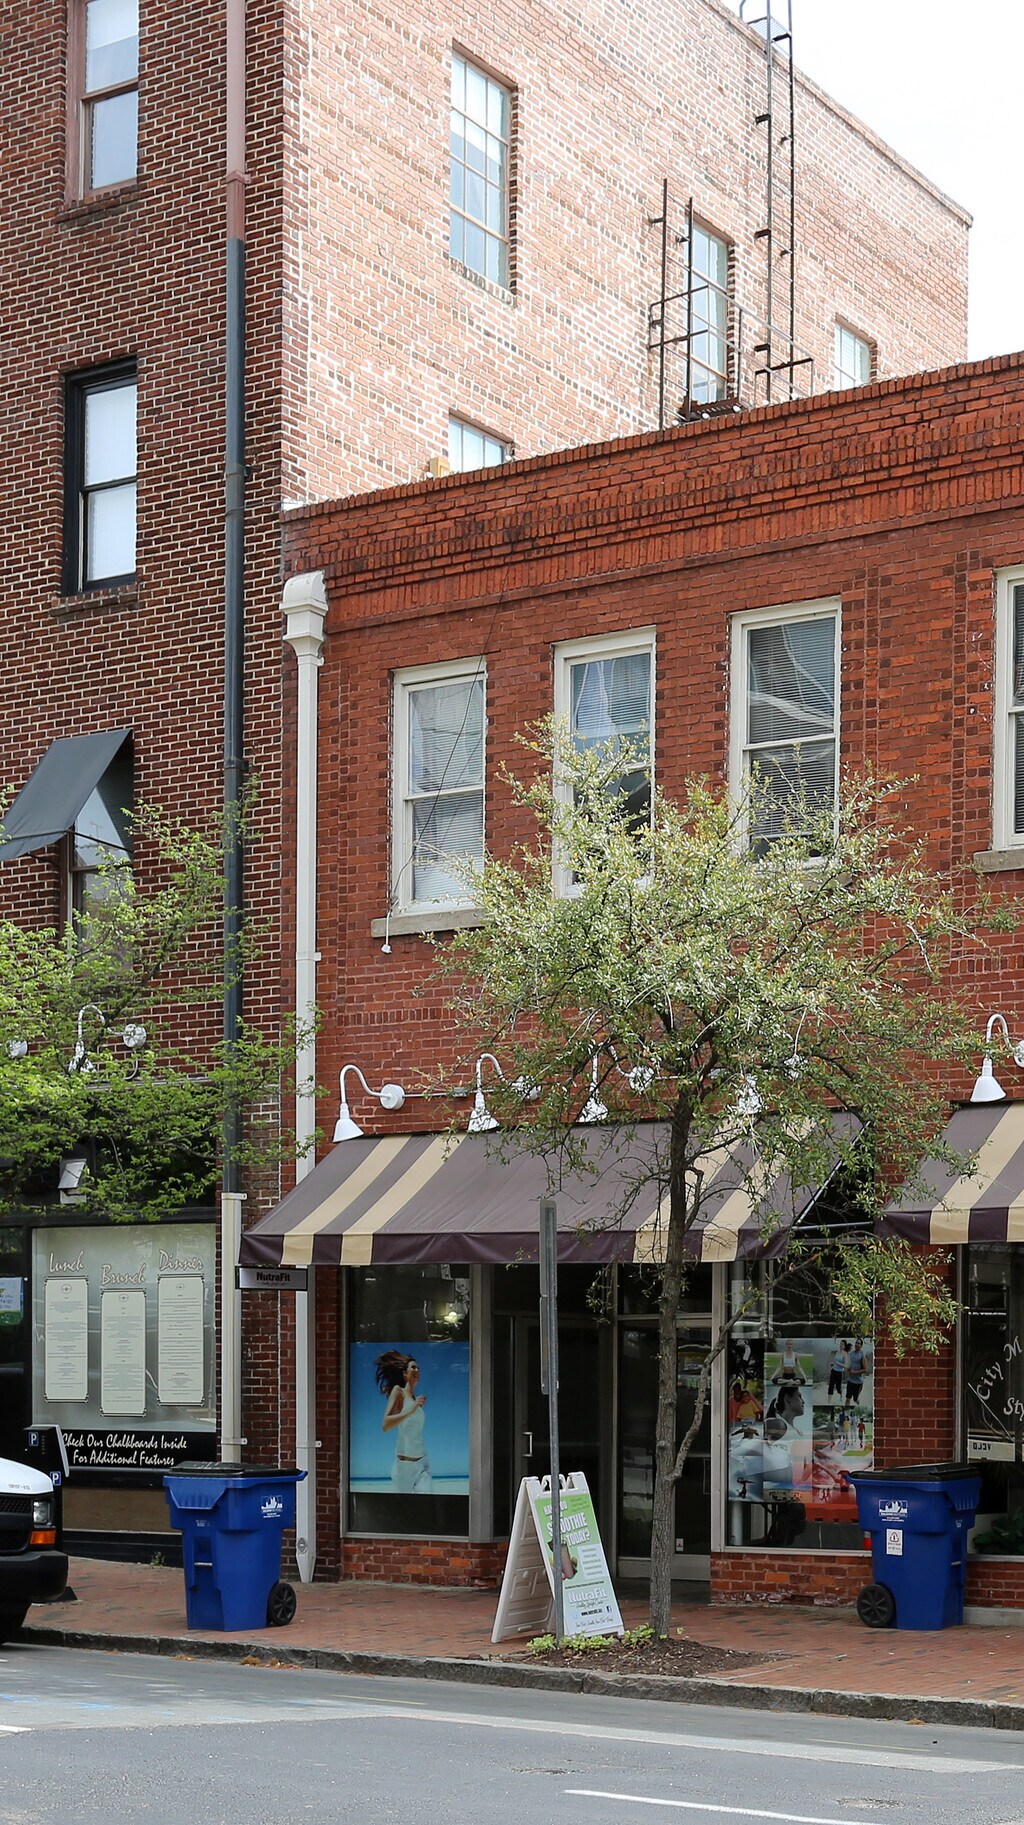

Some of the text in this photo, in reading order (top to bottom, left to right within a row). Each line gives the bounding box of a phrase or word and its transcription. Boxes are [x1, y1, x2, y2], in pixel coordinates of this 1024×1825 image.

[49, 1251, 85, 1273] Lunch
[159, 1249, 205, 1271] Dinner
[101, 1263, 147, 1286] Brunch
[256, 1272, 291, 1282] NutraFit
[976, 1361, 1004, 1400] City
[30, 1432, 37, 1443] P
[62, 1433, 187, 1449] Check Our Chalkboards Inside
[73, 1449, 175, 1466] For Additional Features
[52, 1473, 60, 1483] P
[566, 1528, 591, 1547] TODAY?
[567, 1588, 608, 1603] NutraFit
